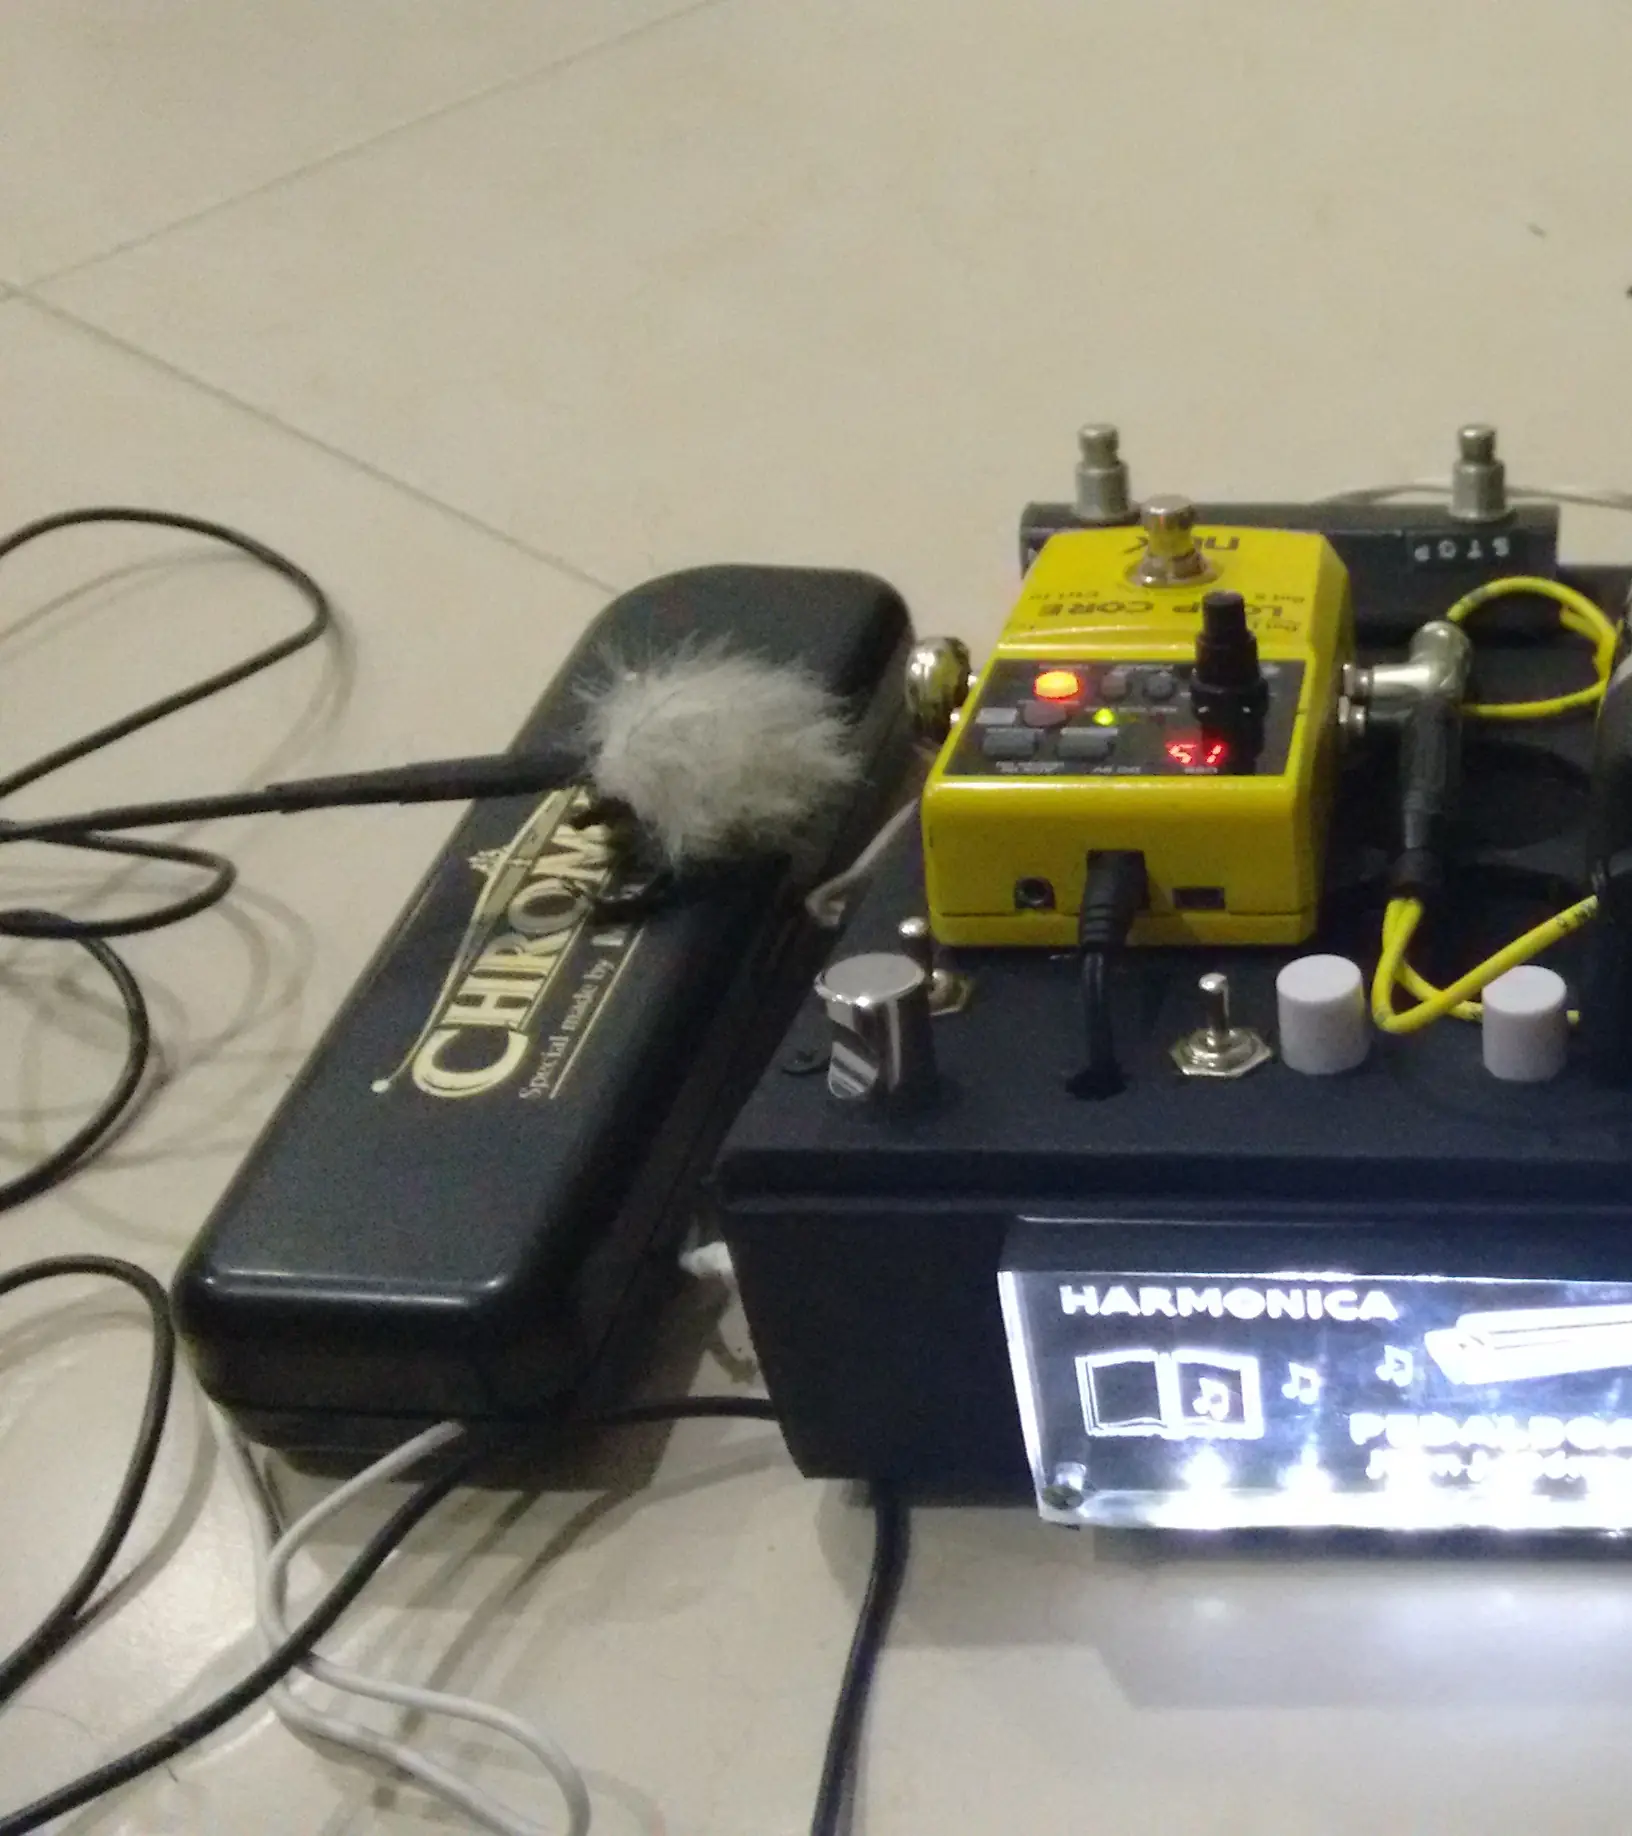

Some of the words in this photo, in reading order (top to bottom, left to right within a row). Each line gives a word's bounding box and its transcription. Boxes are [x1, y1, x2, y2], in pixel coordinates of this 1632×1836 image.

[1413, 536, 1510, 562] STOP
[1037, 600, 1155, 617] CORE
[519, 1034, 570, 1101] Special
[561, 983, 599, 1032] made
[582, 958, 617, 991] by
[1059, 1285, 1399, 1321] HARMONICA
